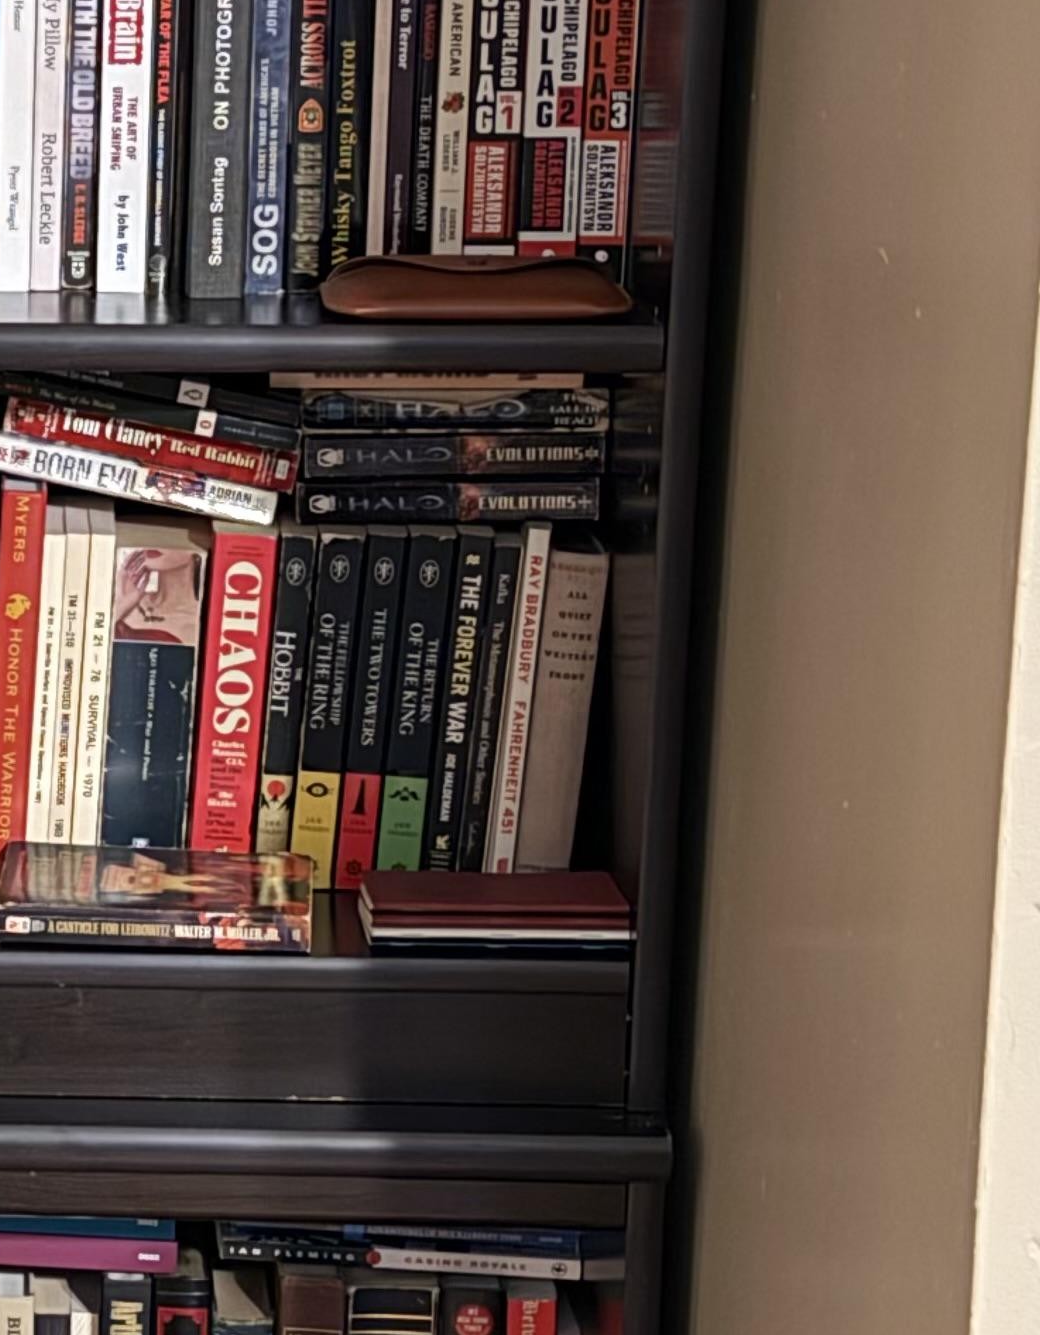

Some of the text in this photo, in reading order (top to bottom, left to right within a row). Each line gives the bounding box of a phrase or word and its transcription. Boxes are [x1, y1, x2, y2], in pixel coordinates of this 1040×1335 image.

[300, 19, 325, 90] ACROSS
[450, 3, 466, 77] AMERICAN
[213, 100, 229, 131] ON
[41, 131, 57, 186] Robert
[114, 195, 128, 272] by John West
[209, 157, 229, 267] Susan Sontag
[252, 204, 278, 275] SOG
[34, 451, 91, 483] BORN
[63, 407, 257, 469] Tom Clancy Red Rabbit
[6, 627, 22, 698] HONOR
[212, 561, 262, 734] CHAOS
[271, 631, 298, 717] HOBBIT
[446, 620, 474, 744] FOREVER WAR
[3, 705, 18, 745] THE
[229, 1247, 356, 1261] IAN FLEMING
